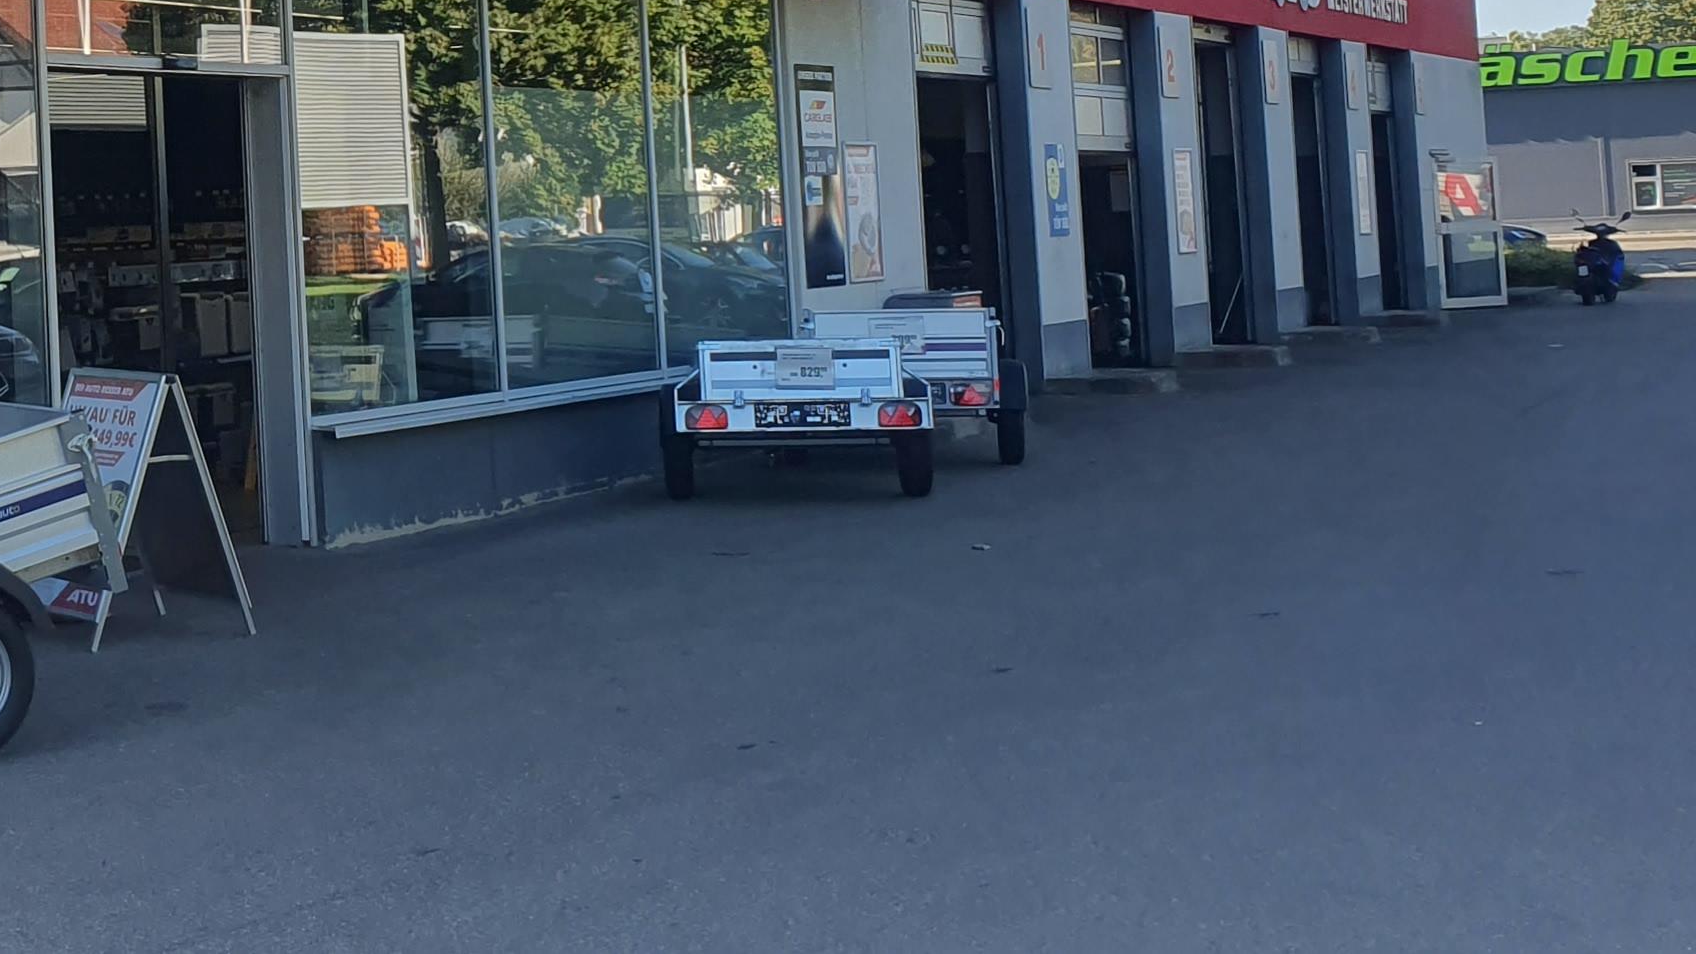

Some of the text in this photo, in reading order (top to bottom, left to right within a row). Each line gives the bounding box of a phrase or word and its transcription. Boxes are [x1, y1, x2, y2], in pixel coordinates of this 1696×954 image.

[1037, 33, 1046, 71] 1
[1166, 49, 1176, 82] 2
[111, 405, 137, 427] FÜR
[66, 589, 99, 606] ATU
